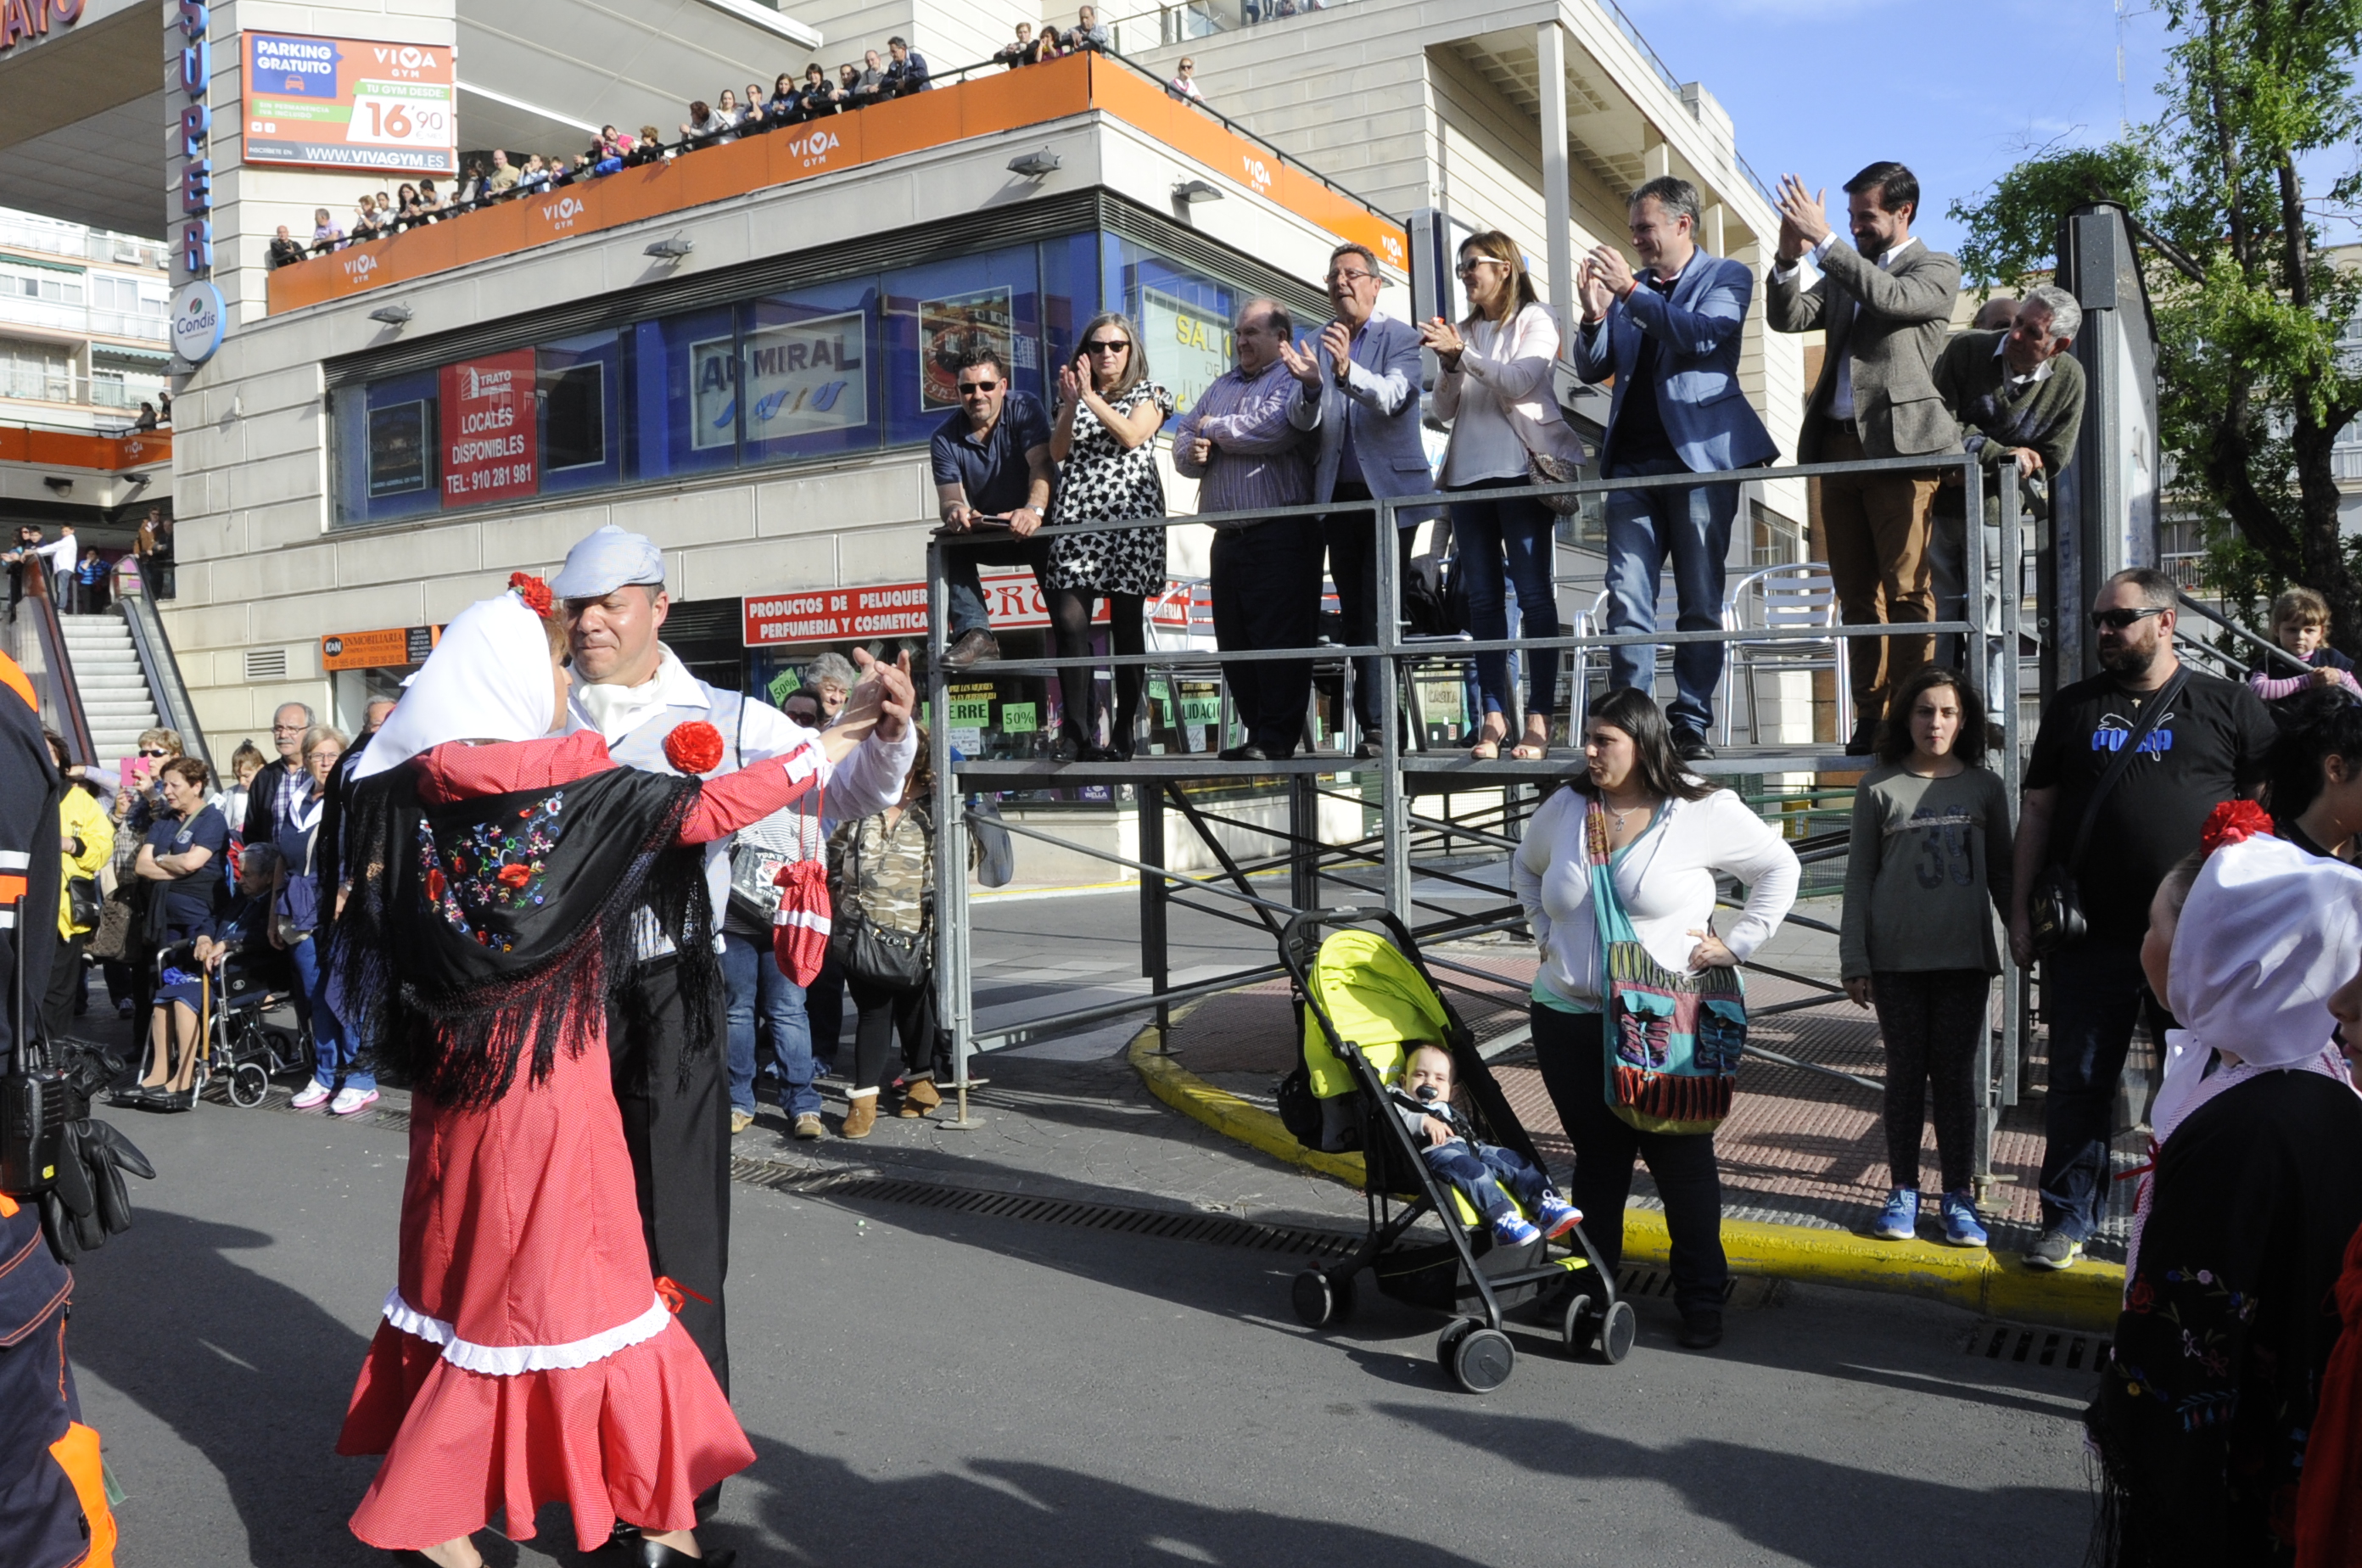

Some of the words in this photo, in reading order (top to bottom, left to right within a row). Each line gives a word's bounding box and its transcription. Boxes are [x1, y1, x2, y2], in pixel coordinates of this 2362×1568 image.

[0, 0, 86, 51] AYO
[256, 41, 333, 60] PARKING
[373, 47, 437, 70] VIVA
[256, 57, 333, 75] GRATUITO
[391, 69, 421, 79] GYM
[366, 84, 380, 93] TU
[381, 85, 408, 96] GYM
[409, 87, 445, 98] DESDE:
[274, 103, 330, 114] PERMANENCIA
[274, 109, 313, 120] INCLUIDO
[178, 0, 213, 272] SUPER
[789, 131, 841, 159] VIVA
[305, 146, 445, 169] WWW.VIVAGYM.ES
[803, 154, 827, 168] GYM
[1243, 155, 1272, 187] VIVA
[1251, 180, 1265, 193] GYM
[543, 197, 585, 221] VIVA
[554, 218, 574, 231] GYM
[344, 255, 378, 275] VIVA
[353, 274, 370, 285] GYM
[176, 311, 215, 334] Condis
[480, 370, 512, 386] TRATO
[462, 407, 514, 434] LOCALES
[452, 434, 525, 465] DISPONIBLES
[446, 473, 470, 494] TEL:
[472, 467, 490, 490] 910
[492, 466, 511, 488] 281
[513, 462, 532, 484] 981
[749, 596, 824, 619] PRODUCTOS
[831, 594, 848, 613] DE
[859, 587, 928, 610] PELUQUER
[760, 618, 838, 640] PERFUMERIA
[841, 617, 851, 633] Y
[854, 611, 929, 633] COSMETICA
[344, 633, 404, 646] INMOBILIARIA
[773, 676, 798, 700] 50%
[949, 703, 988, 720] ERRE
[1005, 711, 1035, 725] 50%
[1164, 703, 1221, 723] LIUIDACI
[1912, 805, 1974, 889] 39
